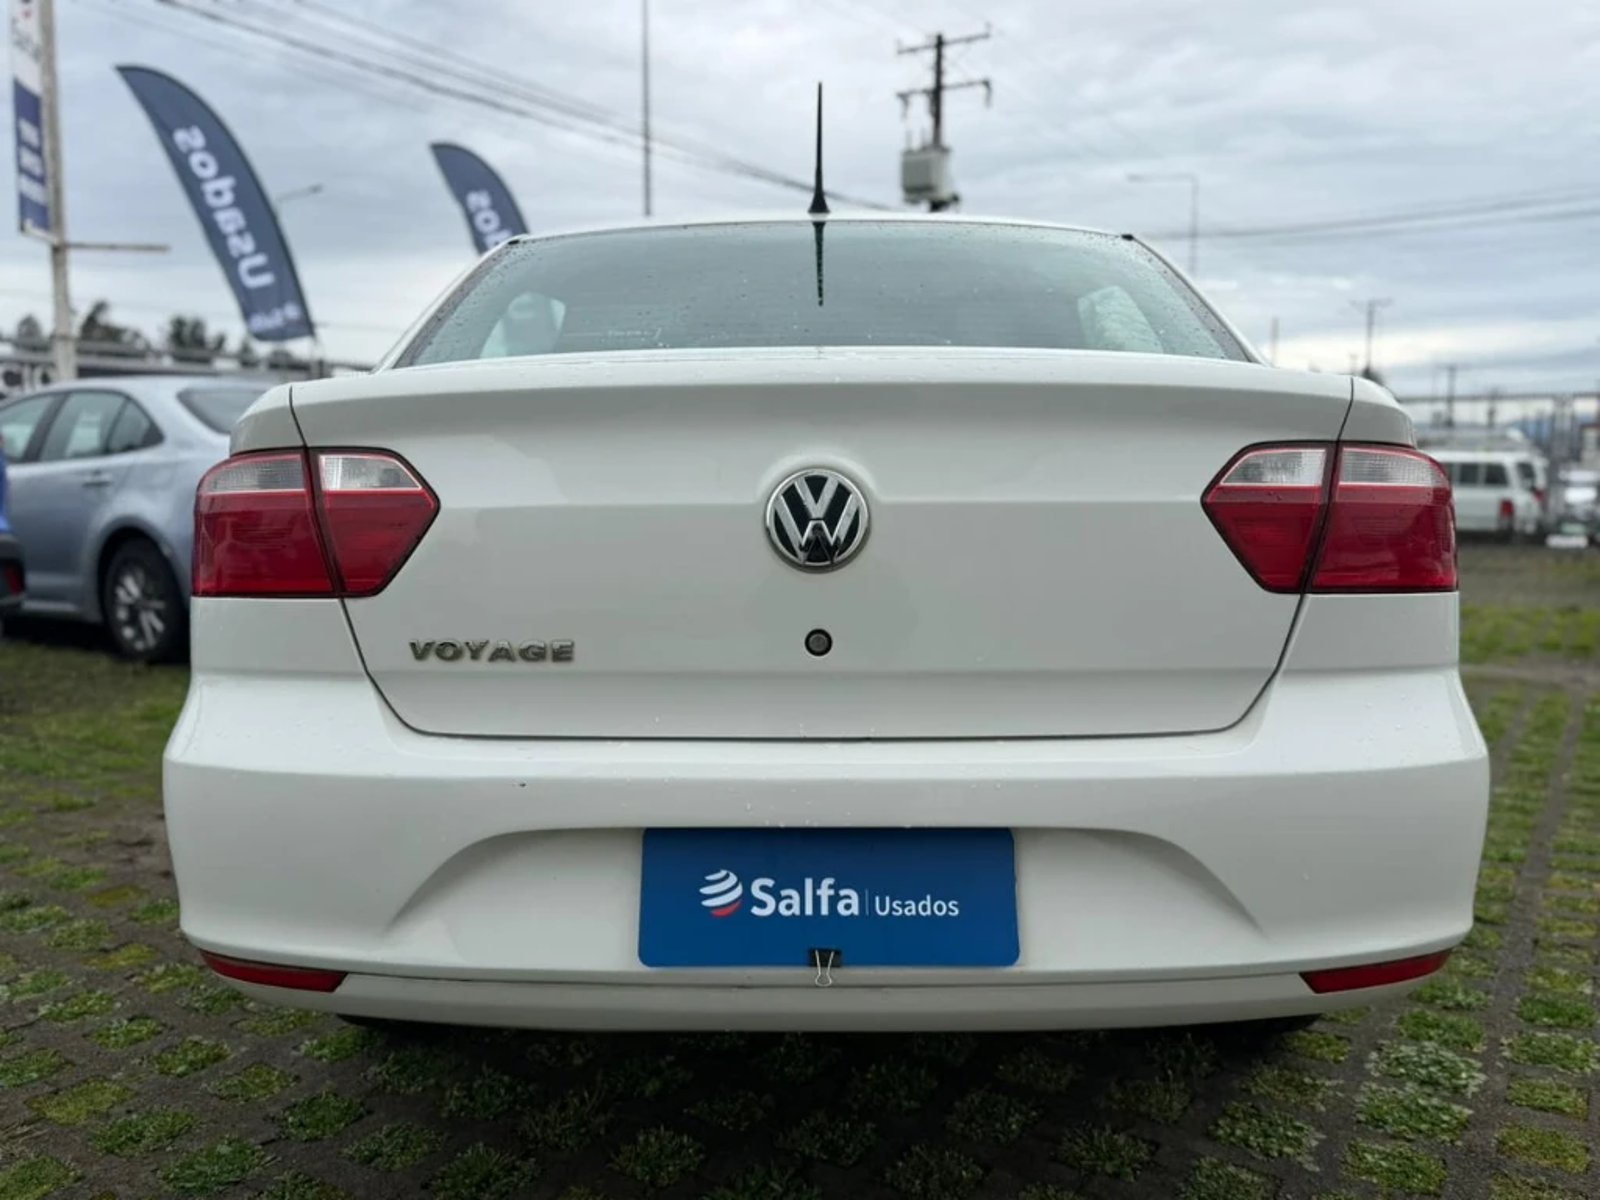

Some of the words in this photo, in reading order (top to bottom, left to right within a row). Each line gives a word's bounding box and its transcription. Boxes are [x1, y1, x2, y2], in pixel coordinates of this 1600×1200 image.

[768, 470, 866, 567] VW
[409, 639, 576, 662] VOYAGE
[750, 877, 860, 917] Salfa
[875, 895, 960, 917] Usados
